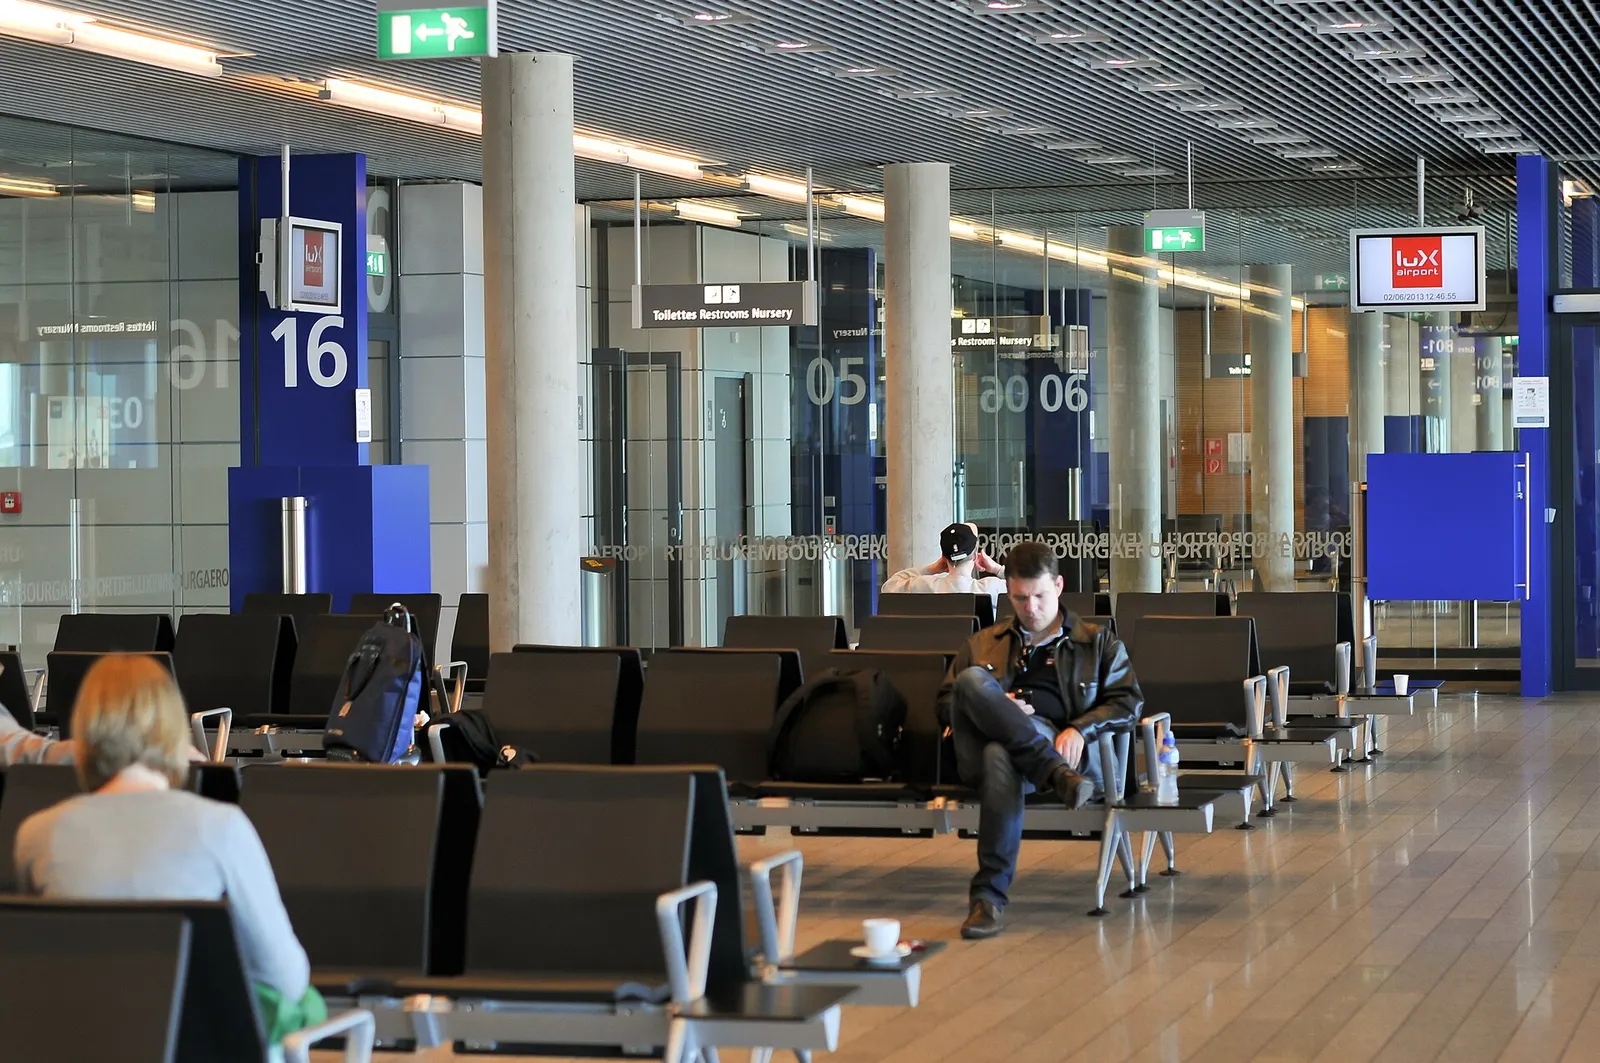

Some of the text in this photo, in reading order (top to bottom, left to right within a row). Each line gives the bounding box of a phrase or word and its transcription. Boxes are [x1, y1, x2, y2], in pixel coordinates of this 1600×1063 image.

[1397, 268, 1438, 277] airport
[1383, 293, 1424, 301] 02/06/2013
[653, 307, 793, 321] Toilettes Restrooms Nursery
[999, 336, 1033, 347] Nursery
[270, 315, 348, 388] 16
[806, 357, 866, 405] 05
[1040, 374, 1088, 412] 06
